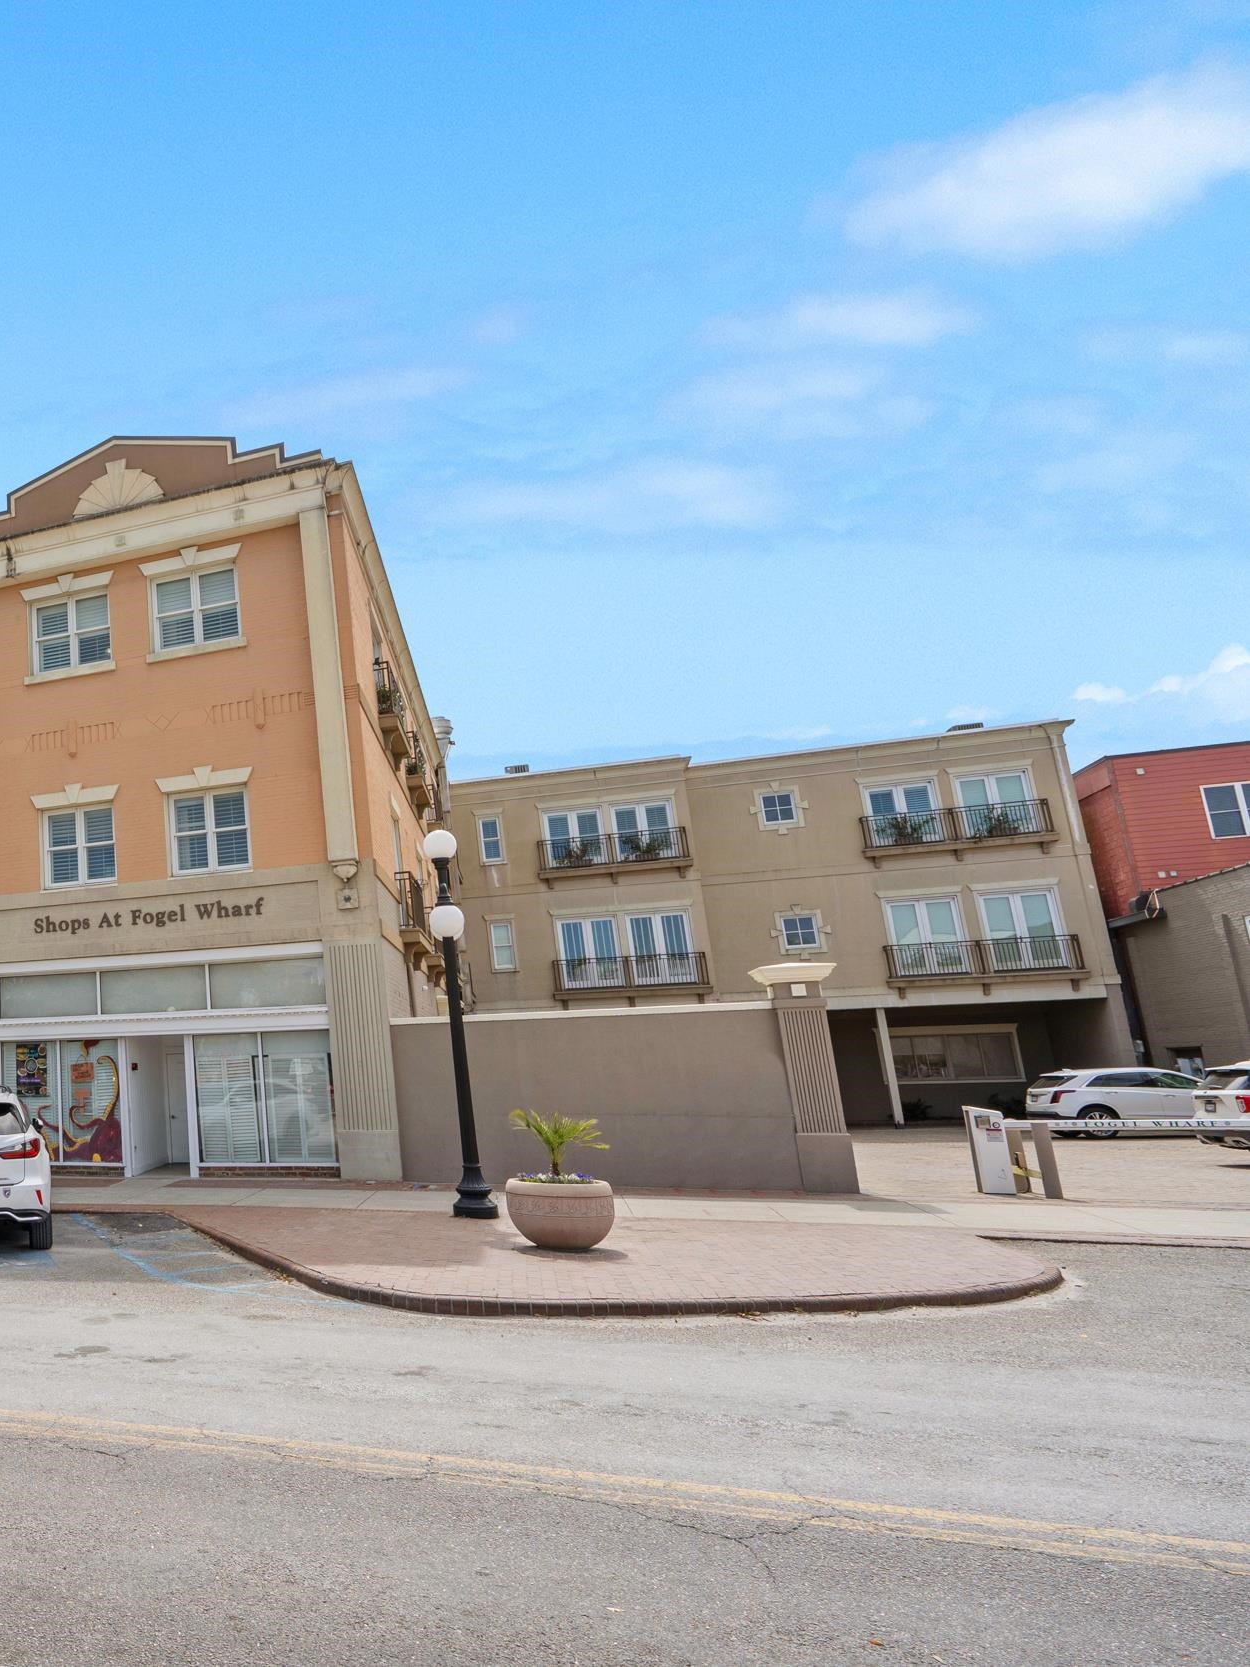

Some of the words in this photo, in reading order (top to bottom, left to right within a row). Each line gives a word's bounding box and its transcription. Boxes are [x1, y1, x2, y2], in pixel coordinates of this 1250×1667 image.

[33, 915, 90, 934] Shops
[98, 911, 121, 928] At
[130, 904, 186, 927] Fogel
[194, 897, 264, 920] Wharf
